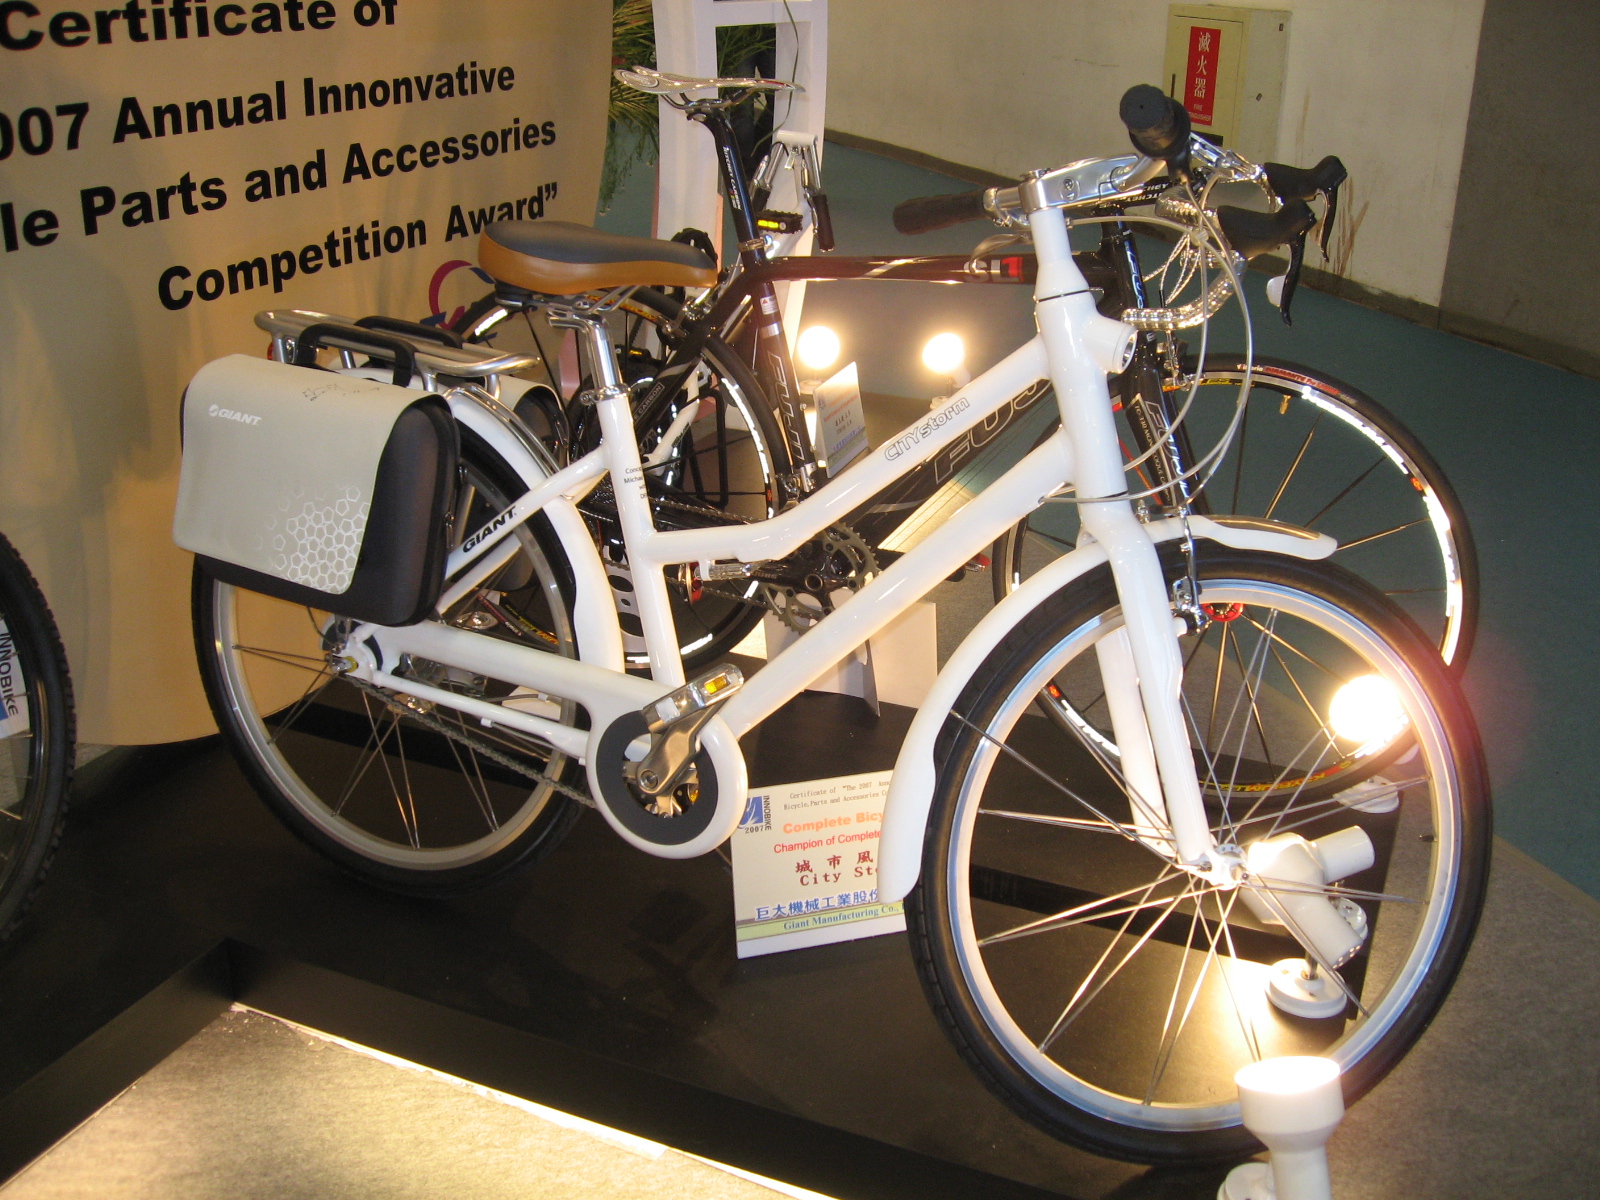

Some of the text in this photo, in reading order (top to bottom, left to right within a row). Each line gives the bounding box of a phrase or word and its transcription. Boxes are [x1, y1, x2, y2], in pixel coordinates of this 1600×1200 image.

[0, 0, 402, 50] Certificate of
[113, 81, 286, 143] Annual
[303, 61, 515, 116] Innonvative
[81, 172, 228, 235] Parts
[245, 149, 327, 203] and
[343, 117, 557, 184] Accessories
[158, 215, 427, 310] Competition
[217, 407, 263, 427] GIANT
[462, 504, 517, 553] GIANT
[790, 789, 828, 799] Certificate
[829, 786, 837, 794] of
[830, 796, 841, 804] and
[842, 791, 880, 802] Accessories
[763, 795, 772, 831] INNOBIKE
[744, 824, 764, 834] 2007
[782, 815, 852, 835] Complete
[773, 837, 823, 854] Champion
[826, 836, 836, 846] of
[800, 871, 842, 887] City
[783, 918, 810, 931] Giant
[812, 906, 879, 926] Manufacturing
